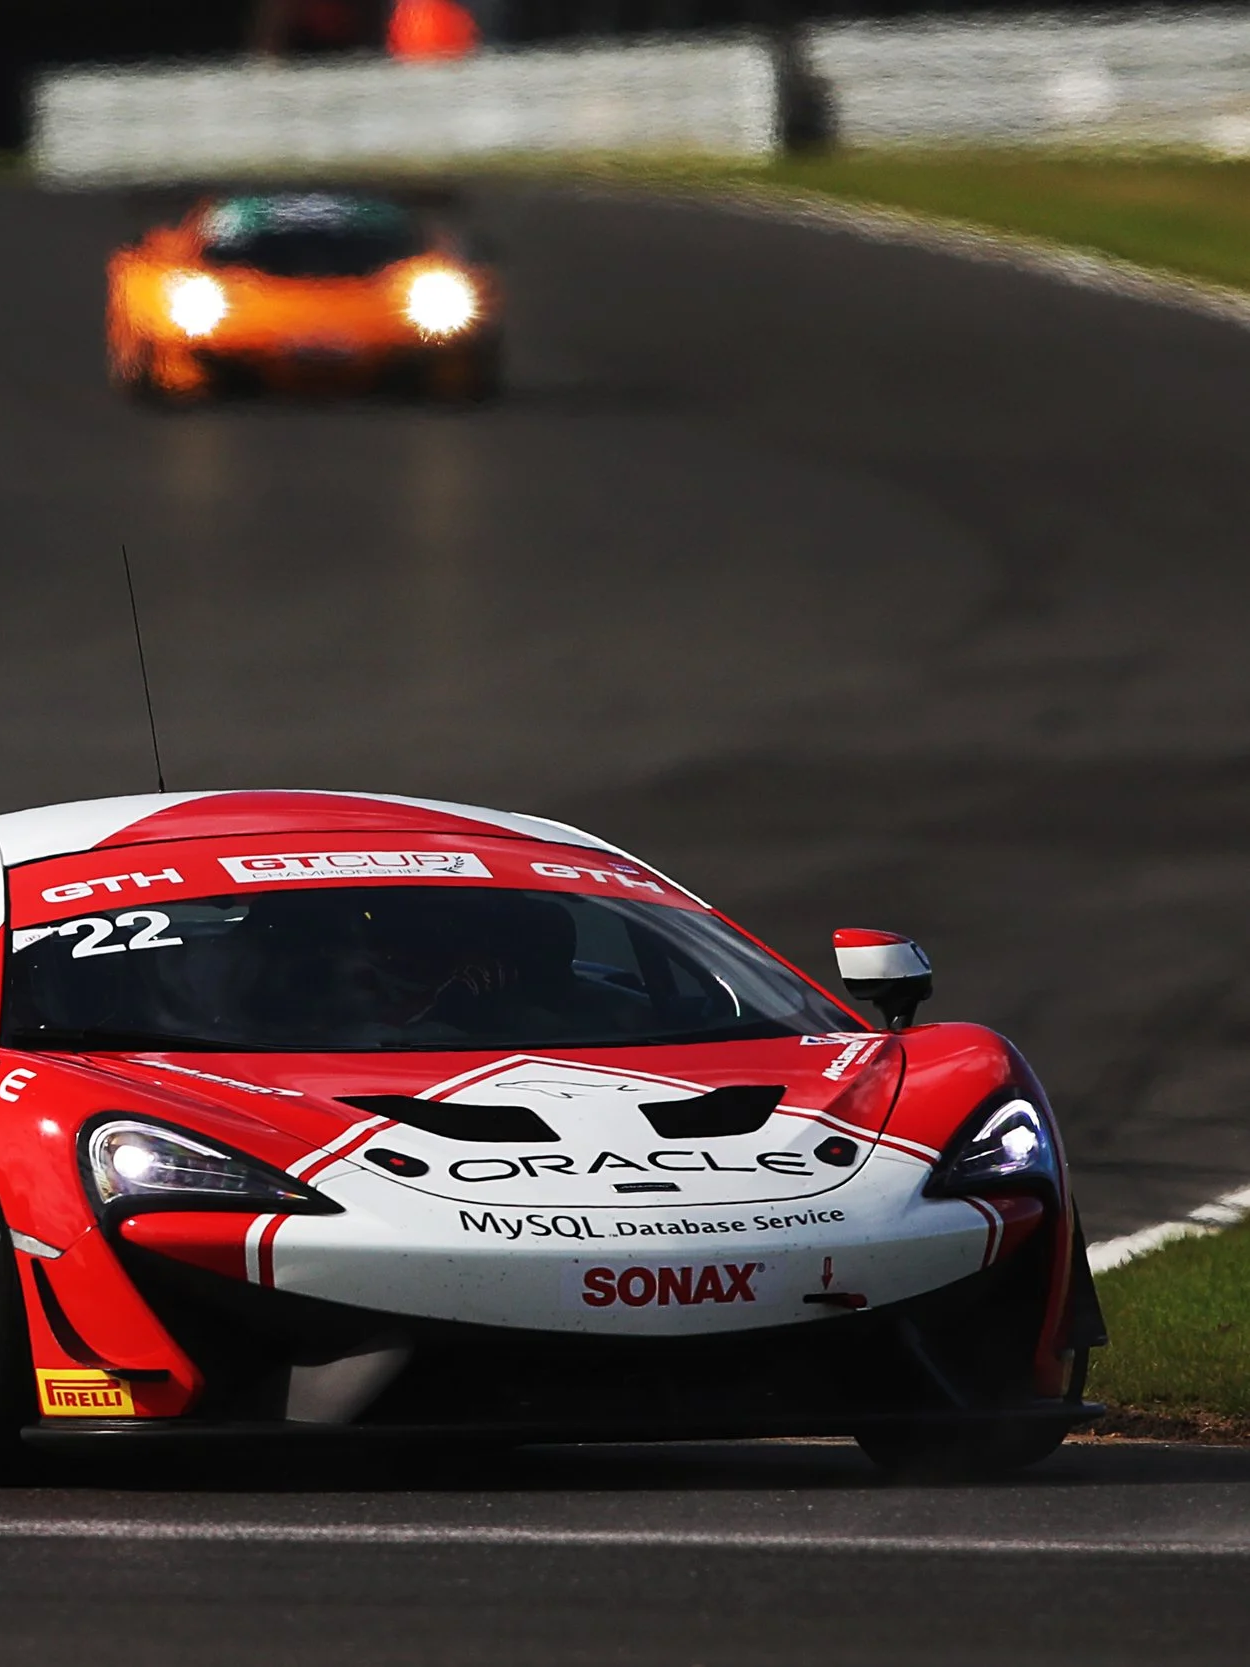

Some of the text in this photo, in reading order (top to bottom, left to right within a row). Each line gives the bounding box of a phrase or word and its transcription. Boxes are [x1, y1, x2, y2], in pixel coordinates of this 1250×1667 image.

[41, 868, 185, 903] GTH
[252, 868, 421, 880] CHAMPIONSHIP
[530, 862, 666, 895] GTH
[59, 910, 184, 959] 22
[448, 1150, 815, 1183] ORACLE
[459, 1208, 846, 1241] MySQL Database Service
[45, 1379, 123, 1407] PIRELLI
